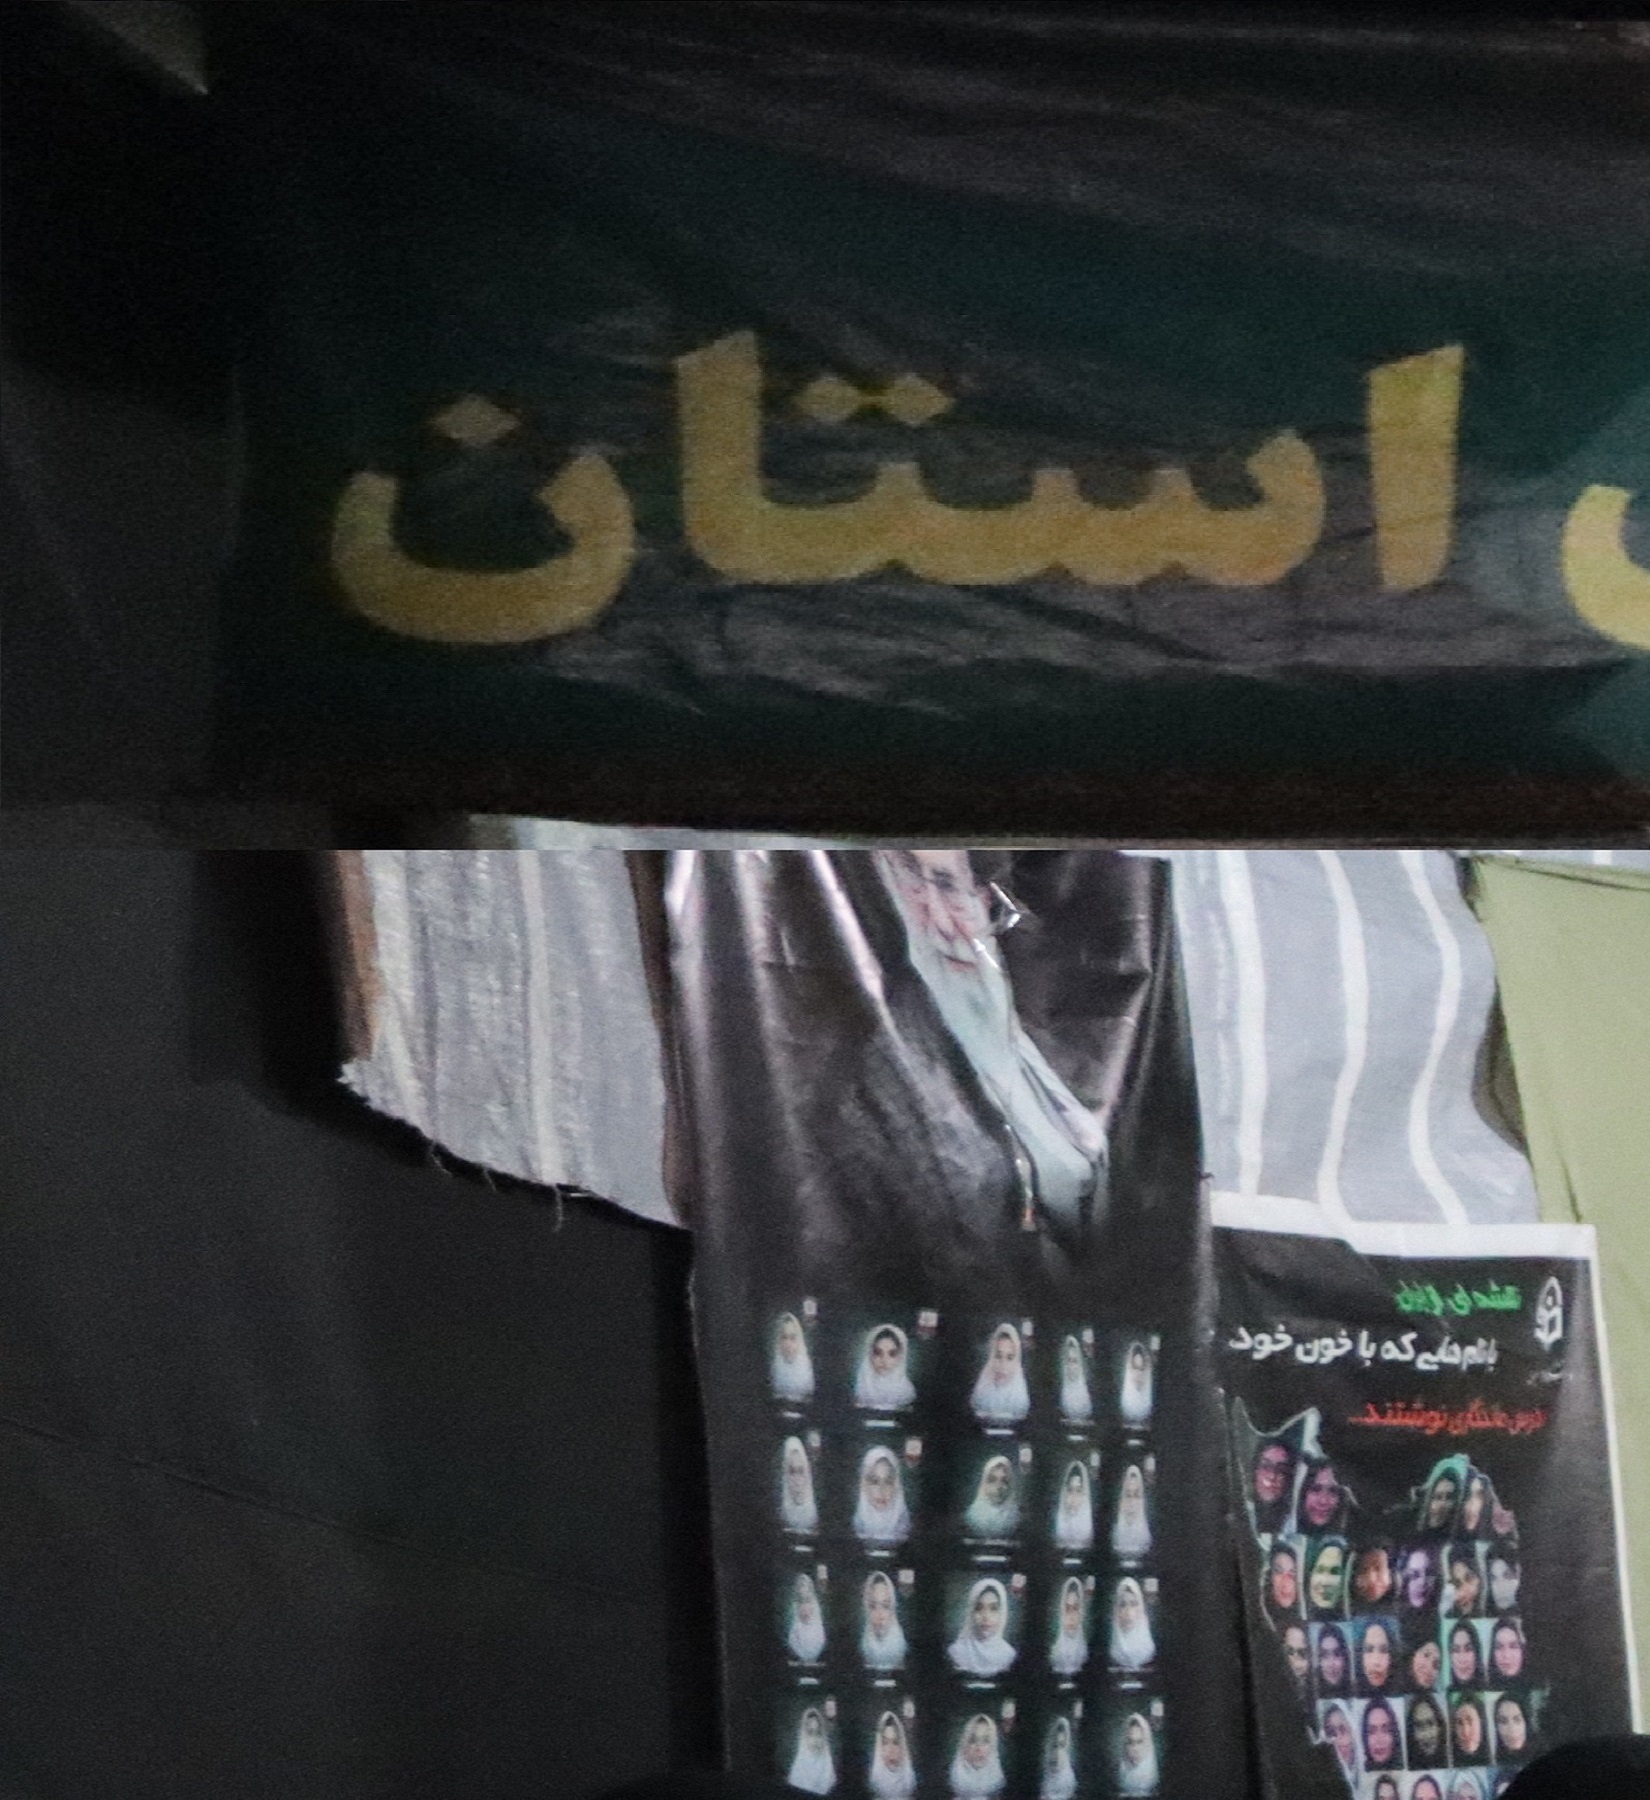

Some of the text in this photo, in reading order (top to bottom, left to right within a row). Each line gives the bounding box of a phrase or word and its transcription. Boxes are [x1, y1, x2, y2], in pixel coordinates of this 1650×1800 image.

[330, 330, 1464, 645] استان
[1228, 1323, 1294, 1361] خود
[1295, 1328, 1353, 1365] خون
[1358, 1329, 1377, 1368] با
[1380, 1331, 1417, 1362] که
